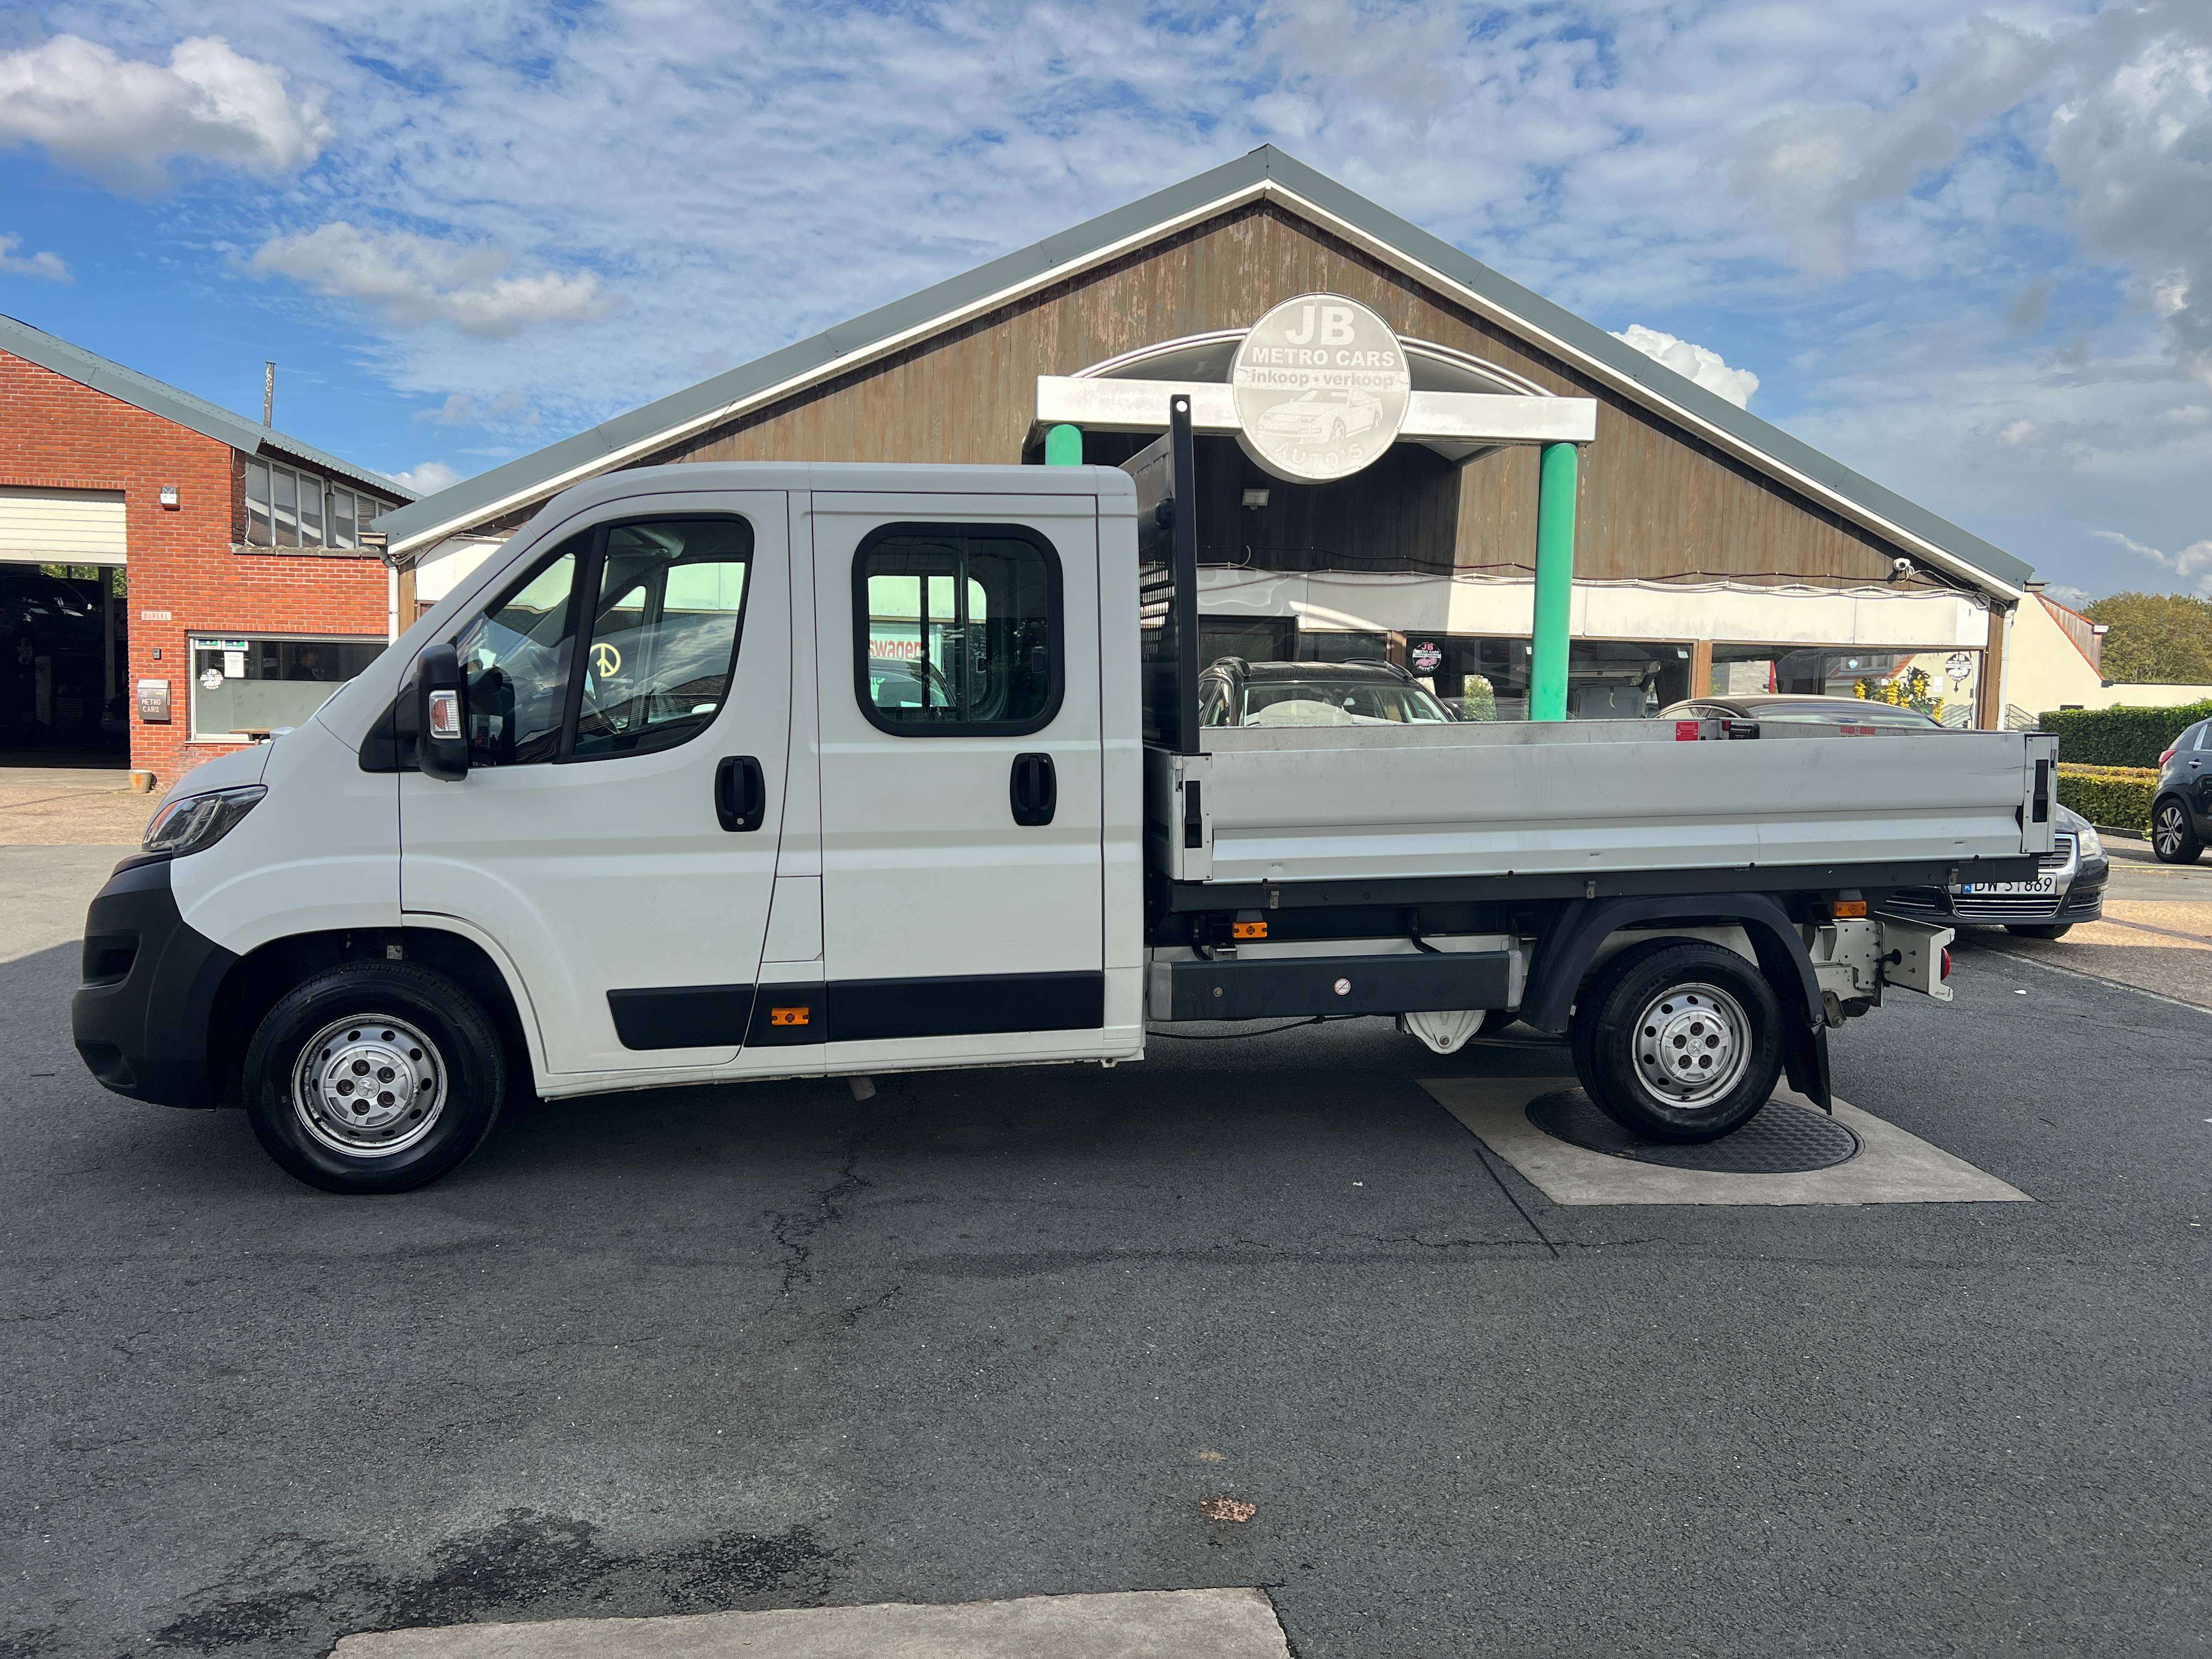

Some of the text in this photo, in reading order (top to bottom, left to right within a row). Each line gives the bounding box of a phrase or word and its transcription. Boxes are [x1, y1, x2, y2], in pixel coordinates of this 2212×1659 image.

[1284, 305, 1356, 346] JB
[1252, 347, 1395, 367] METRO CARS
[1251, 369, 1394, 389] inkoop verkoop
[1274, 443, 1364, 468] AUTO'S
